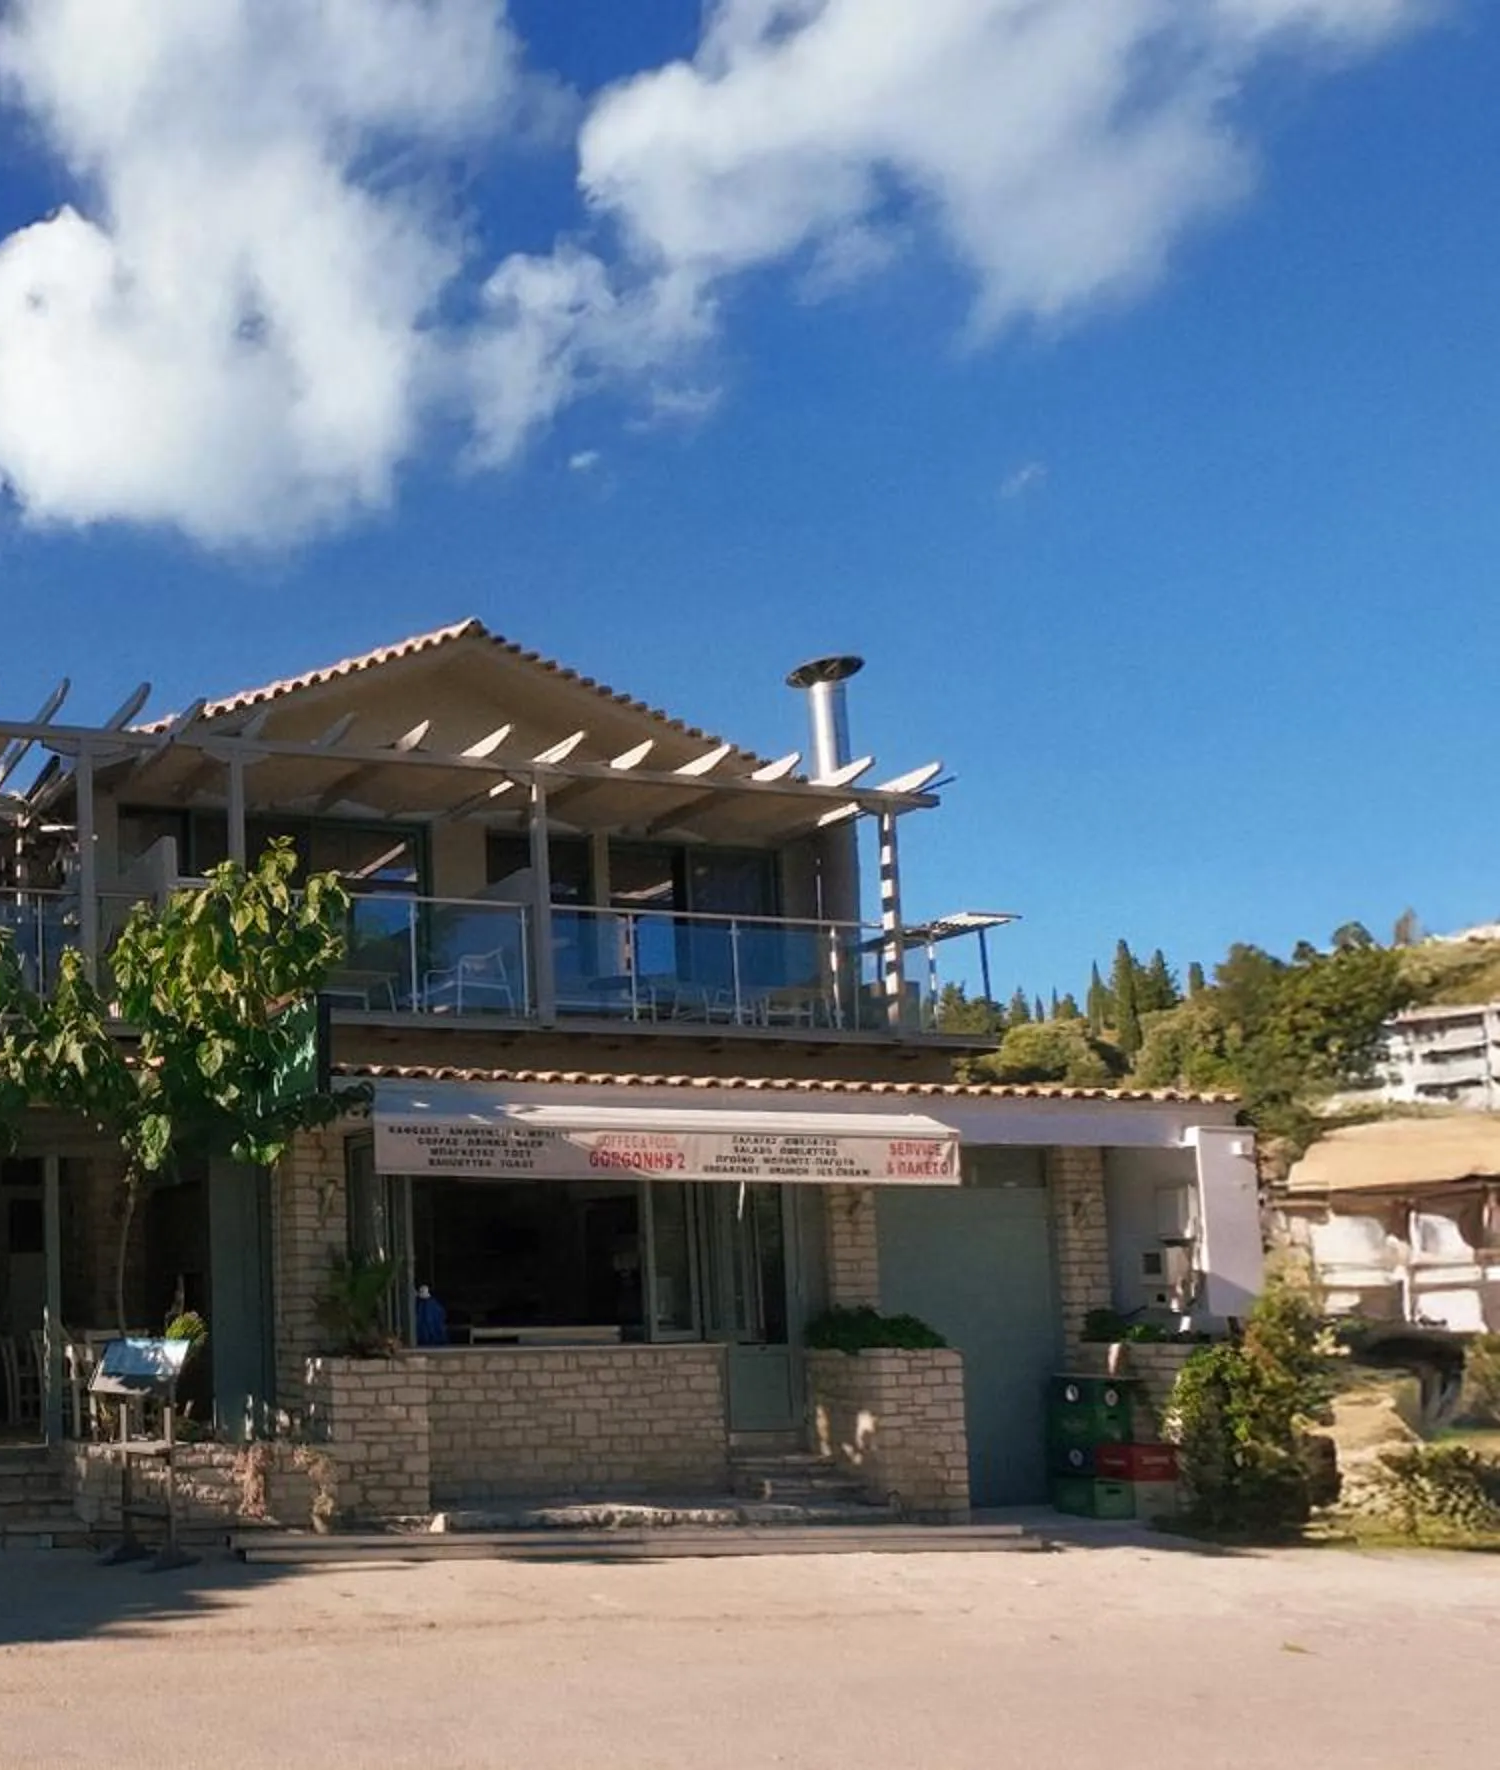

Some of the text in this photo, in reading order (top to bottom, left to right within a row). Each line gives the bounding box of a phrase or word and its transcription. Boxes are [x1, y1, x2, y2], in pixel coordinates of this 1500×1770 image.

[890, 1142, 943, 1156] SERVICE
[589, 1150, 686, 1169] GORGONHS 2
